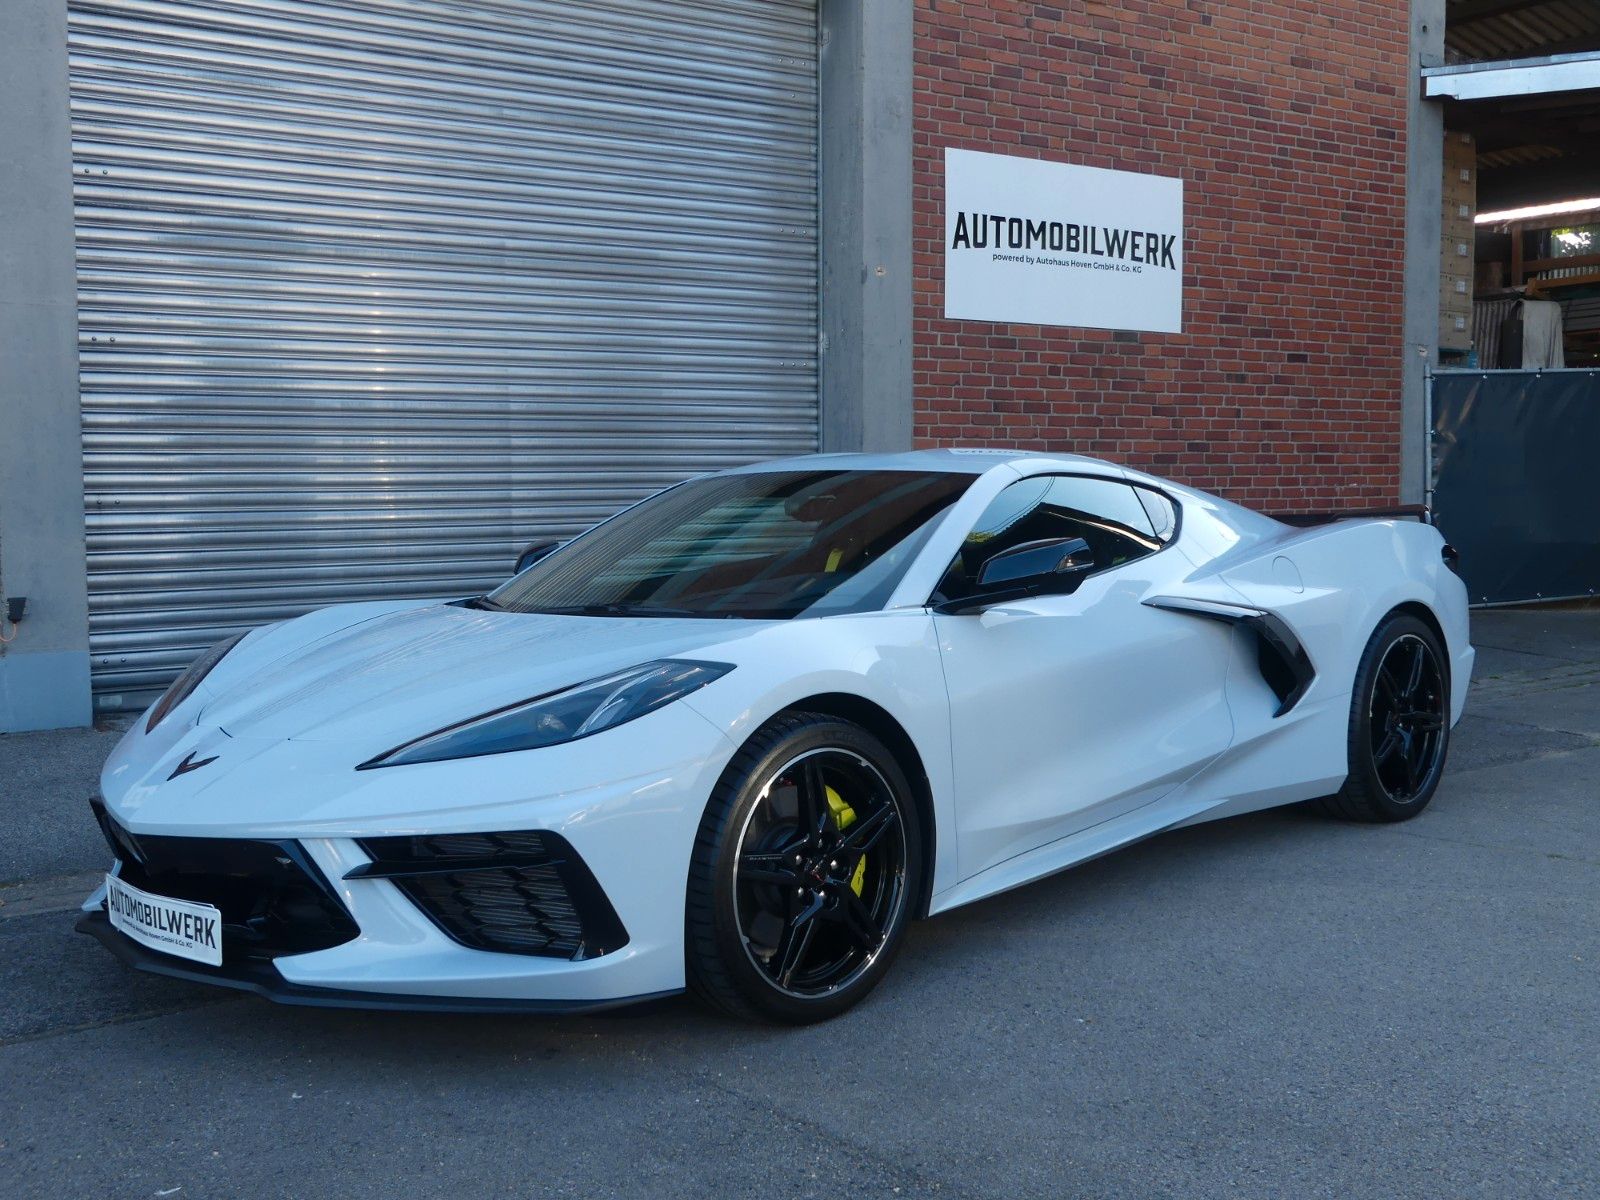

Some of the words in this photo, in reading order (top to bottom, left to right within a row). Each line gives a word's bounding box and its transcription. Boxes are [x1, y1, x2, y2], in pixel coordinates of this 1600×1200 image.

[952, 212, 1176, 270] AUTOMOBILWERK
[992, 254, 1024, 264] powered
[1026, 255, 1034, 264] by
[1036, 257, 1070, 267] Autohaus
[1071, 261, 1092, 269] Hoven
[1093, 262, 1115, 271] GmbH
[110, 886, 216, 949] AUTOMOBILWERK
